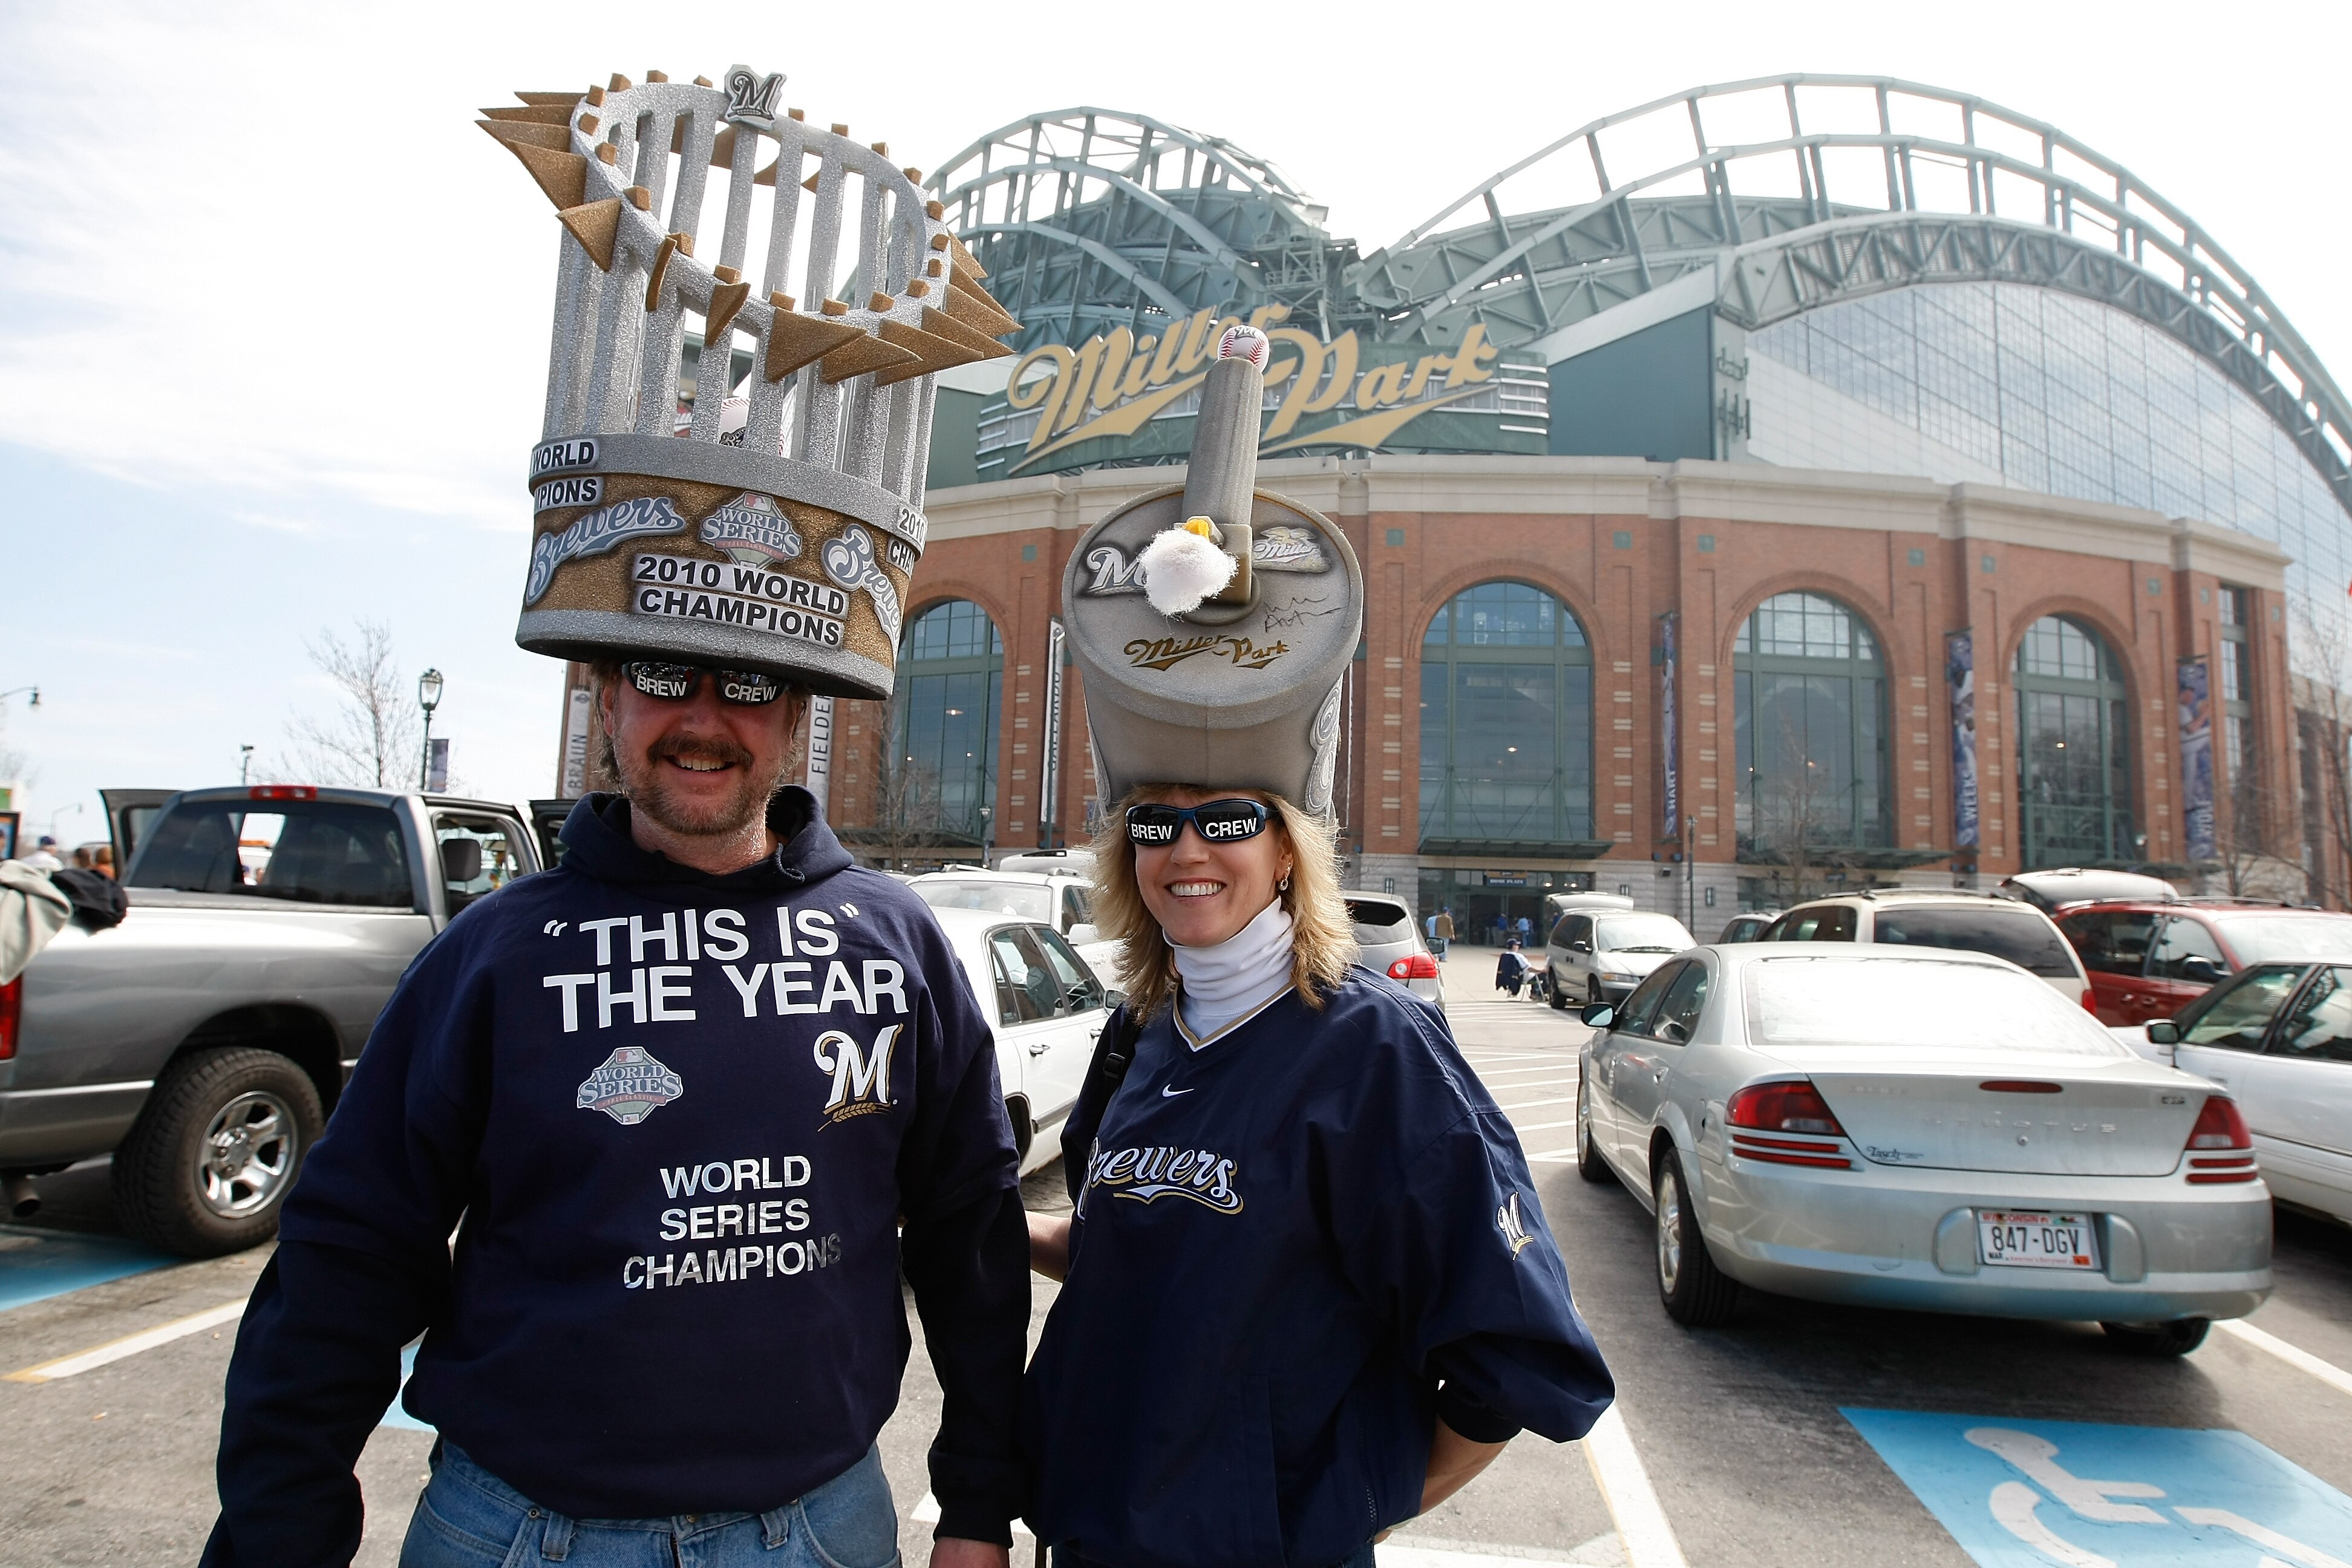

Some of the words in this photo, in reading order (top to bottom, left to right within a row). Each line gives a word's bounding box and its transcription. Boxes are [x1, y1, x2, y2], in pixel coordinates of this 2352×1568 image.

[730, 71, 782, 115] M
[1259, 323, 1499, 442] Park
[701, 517, 801, 557] SERIES
[720, 507, 790, 534] WORLD
[900, 508, 926, 542] 2010
[527, 498, 686, 604] Brewers
[1253, 540, 1319, 560] Miller
[636, 557, 721, 587] 2010
[733, 567, 844, 615] WORLD
[639, 589, 840, 645] CHAMPIONS
[1124, 635, 1229, 665] Miller
[1212, 637, 1290, 664] Park
[636, 675, 687, 696] BREW
[725, 682, 777, 702] CREW
[567, 734, 587, 789] BRAUN
[1131, 823, 1173, 840] BREW
[1206, 817, 1257, 837] CREW
[543, 965, 696, 1033] THE
[722, 959, 909, 1018] YEAR
[595, 1065, 665, 1082] WORLD
[814, 1022, 903, 1115] M
[580, 1076, 681, 1105] SERIES
[660, 1155, 811, 1198] WORLD
[660, 1198, 810, 1241] SERIES
[624, 1232, 842, 1289] CHAMPIONS
